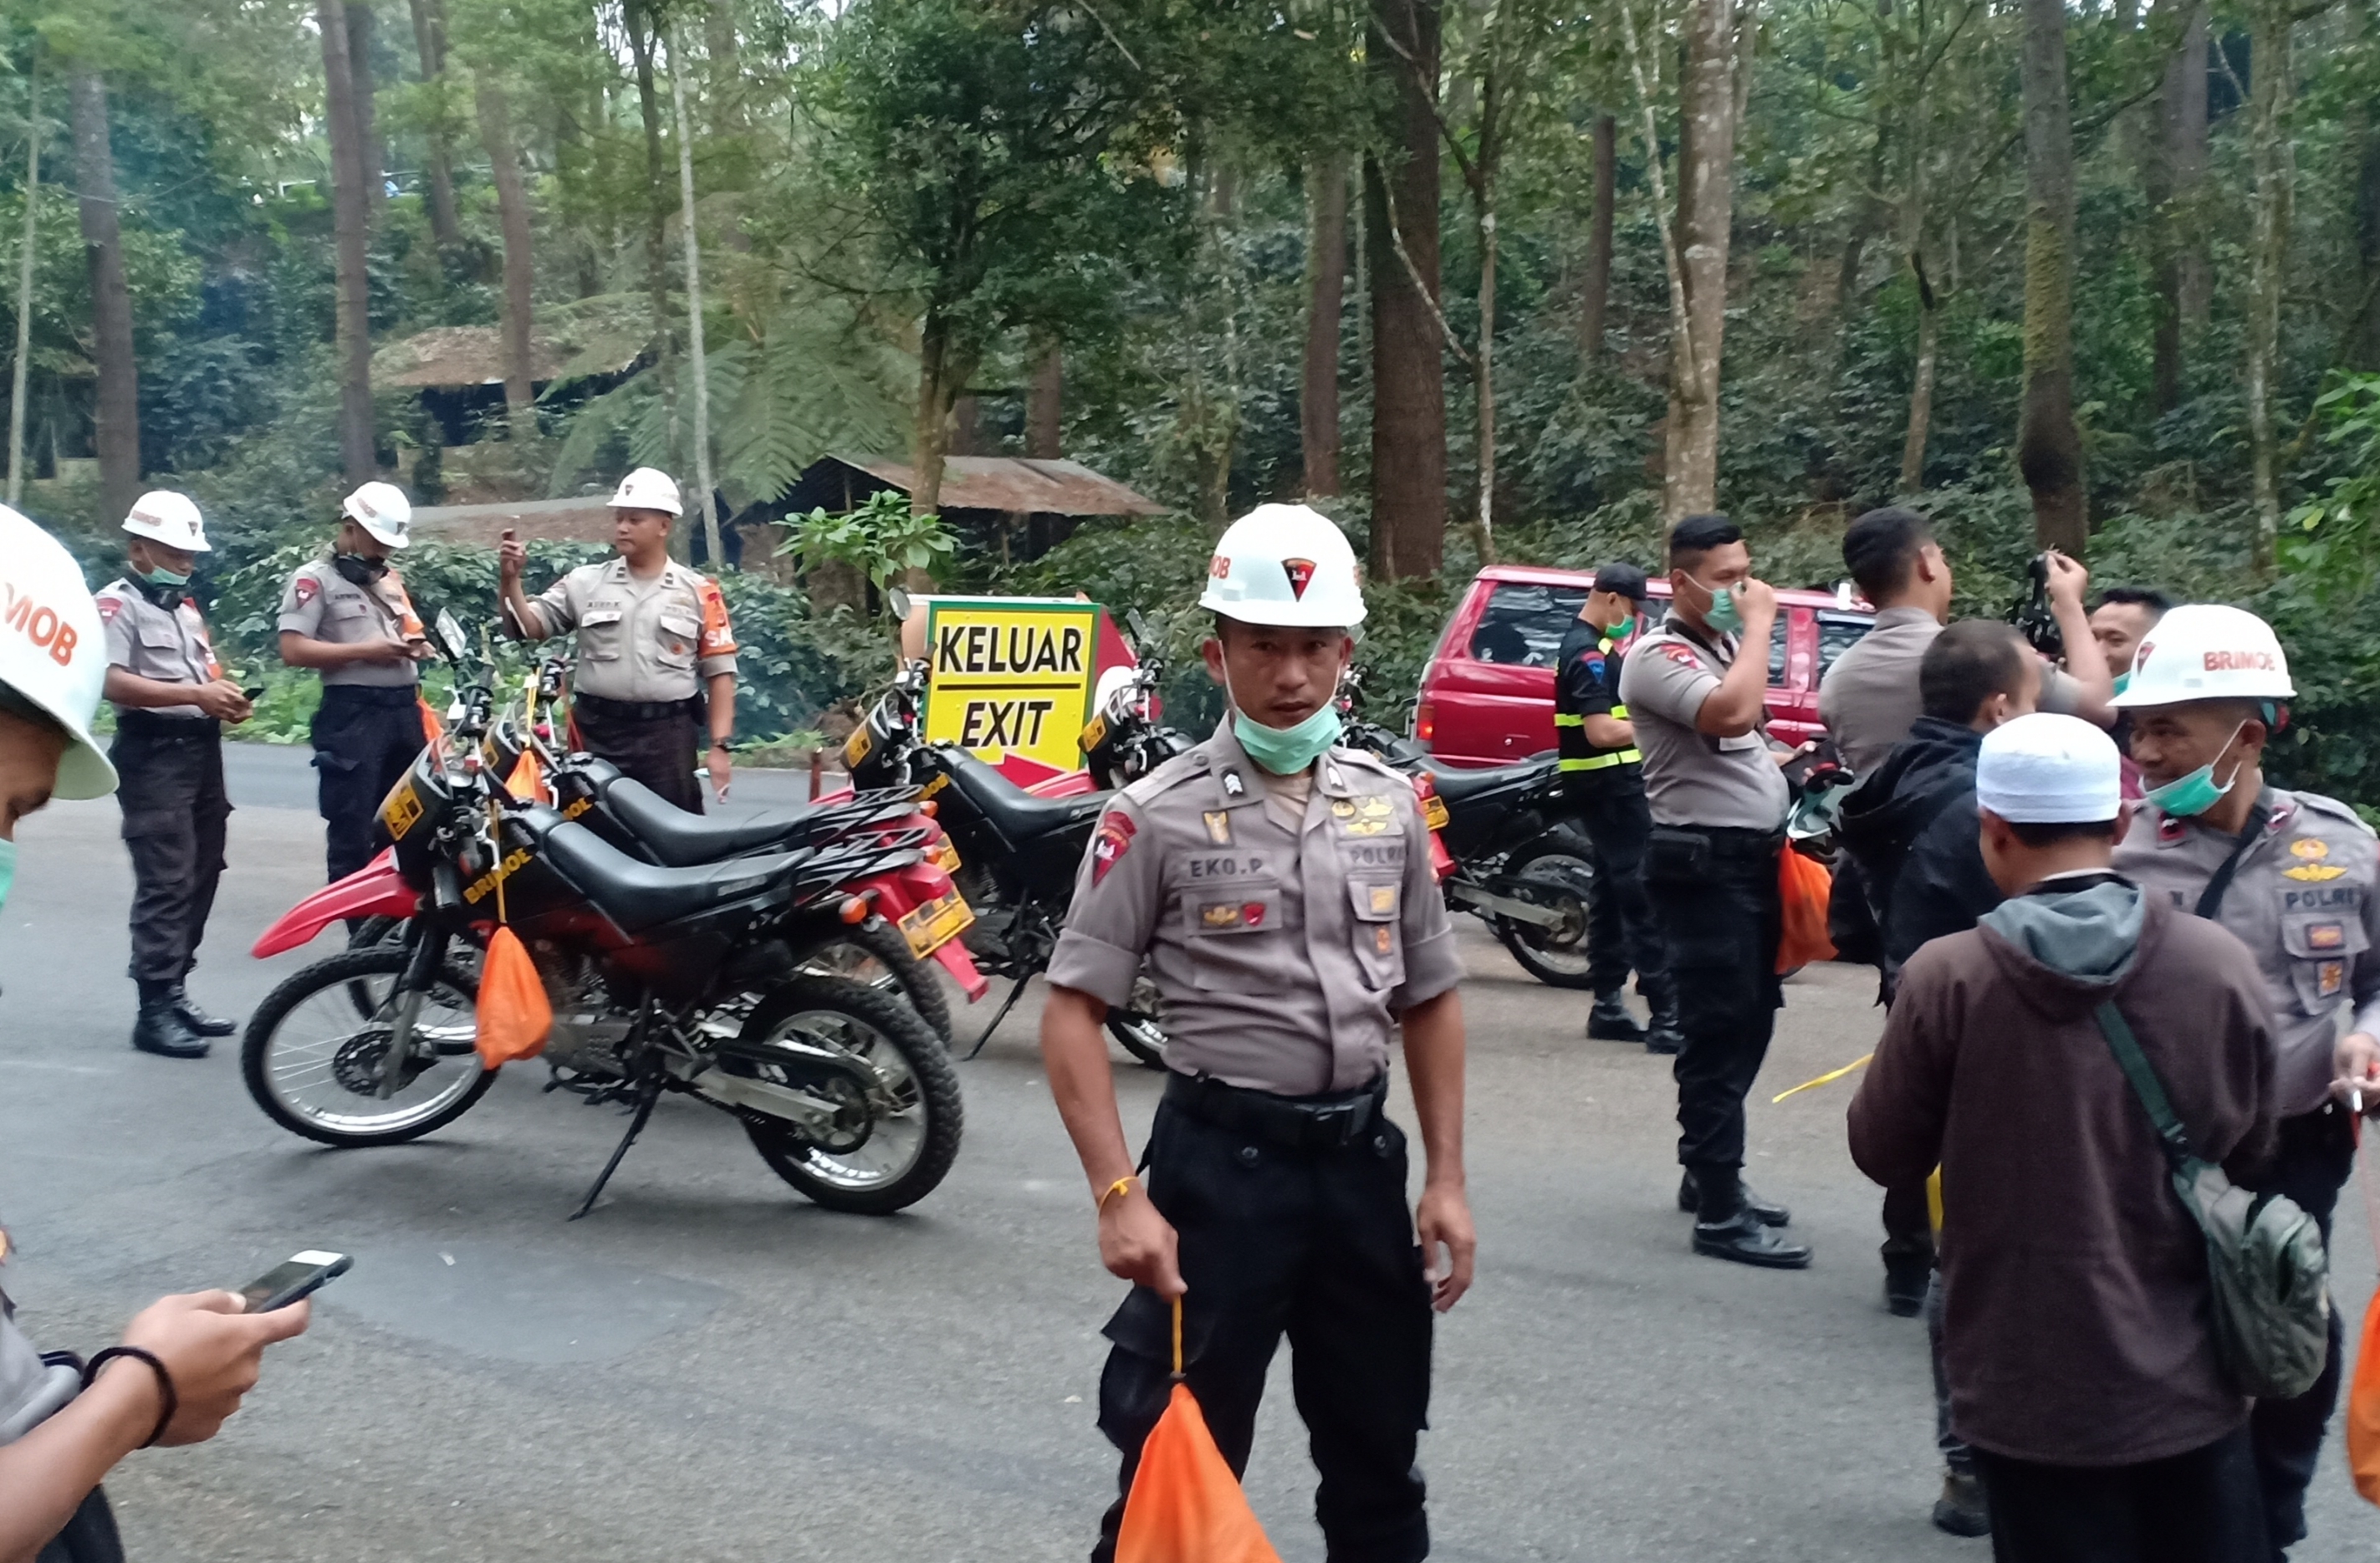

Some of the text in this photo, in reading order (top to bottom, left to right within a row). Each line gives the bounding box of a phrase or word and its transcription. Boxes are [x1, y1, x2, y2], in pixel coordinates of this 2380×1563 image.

[938, 626, 1081, 673] KELUAR
[961, 700, 1053, 748] EXIT
[1189, 857, 1264, 878] EKO.P
[2285, 887, 2355, 910] POLRI
